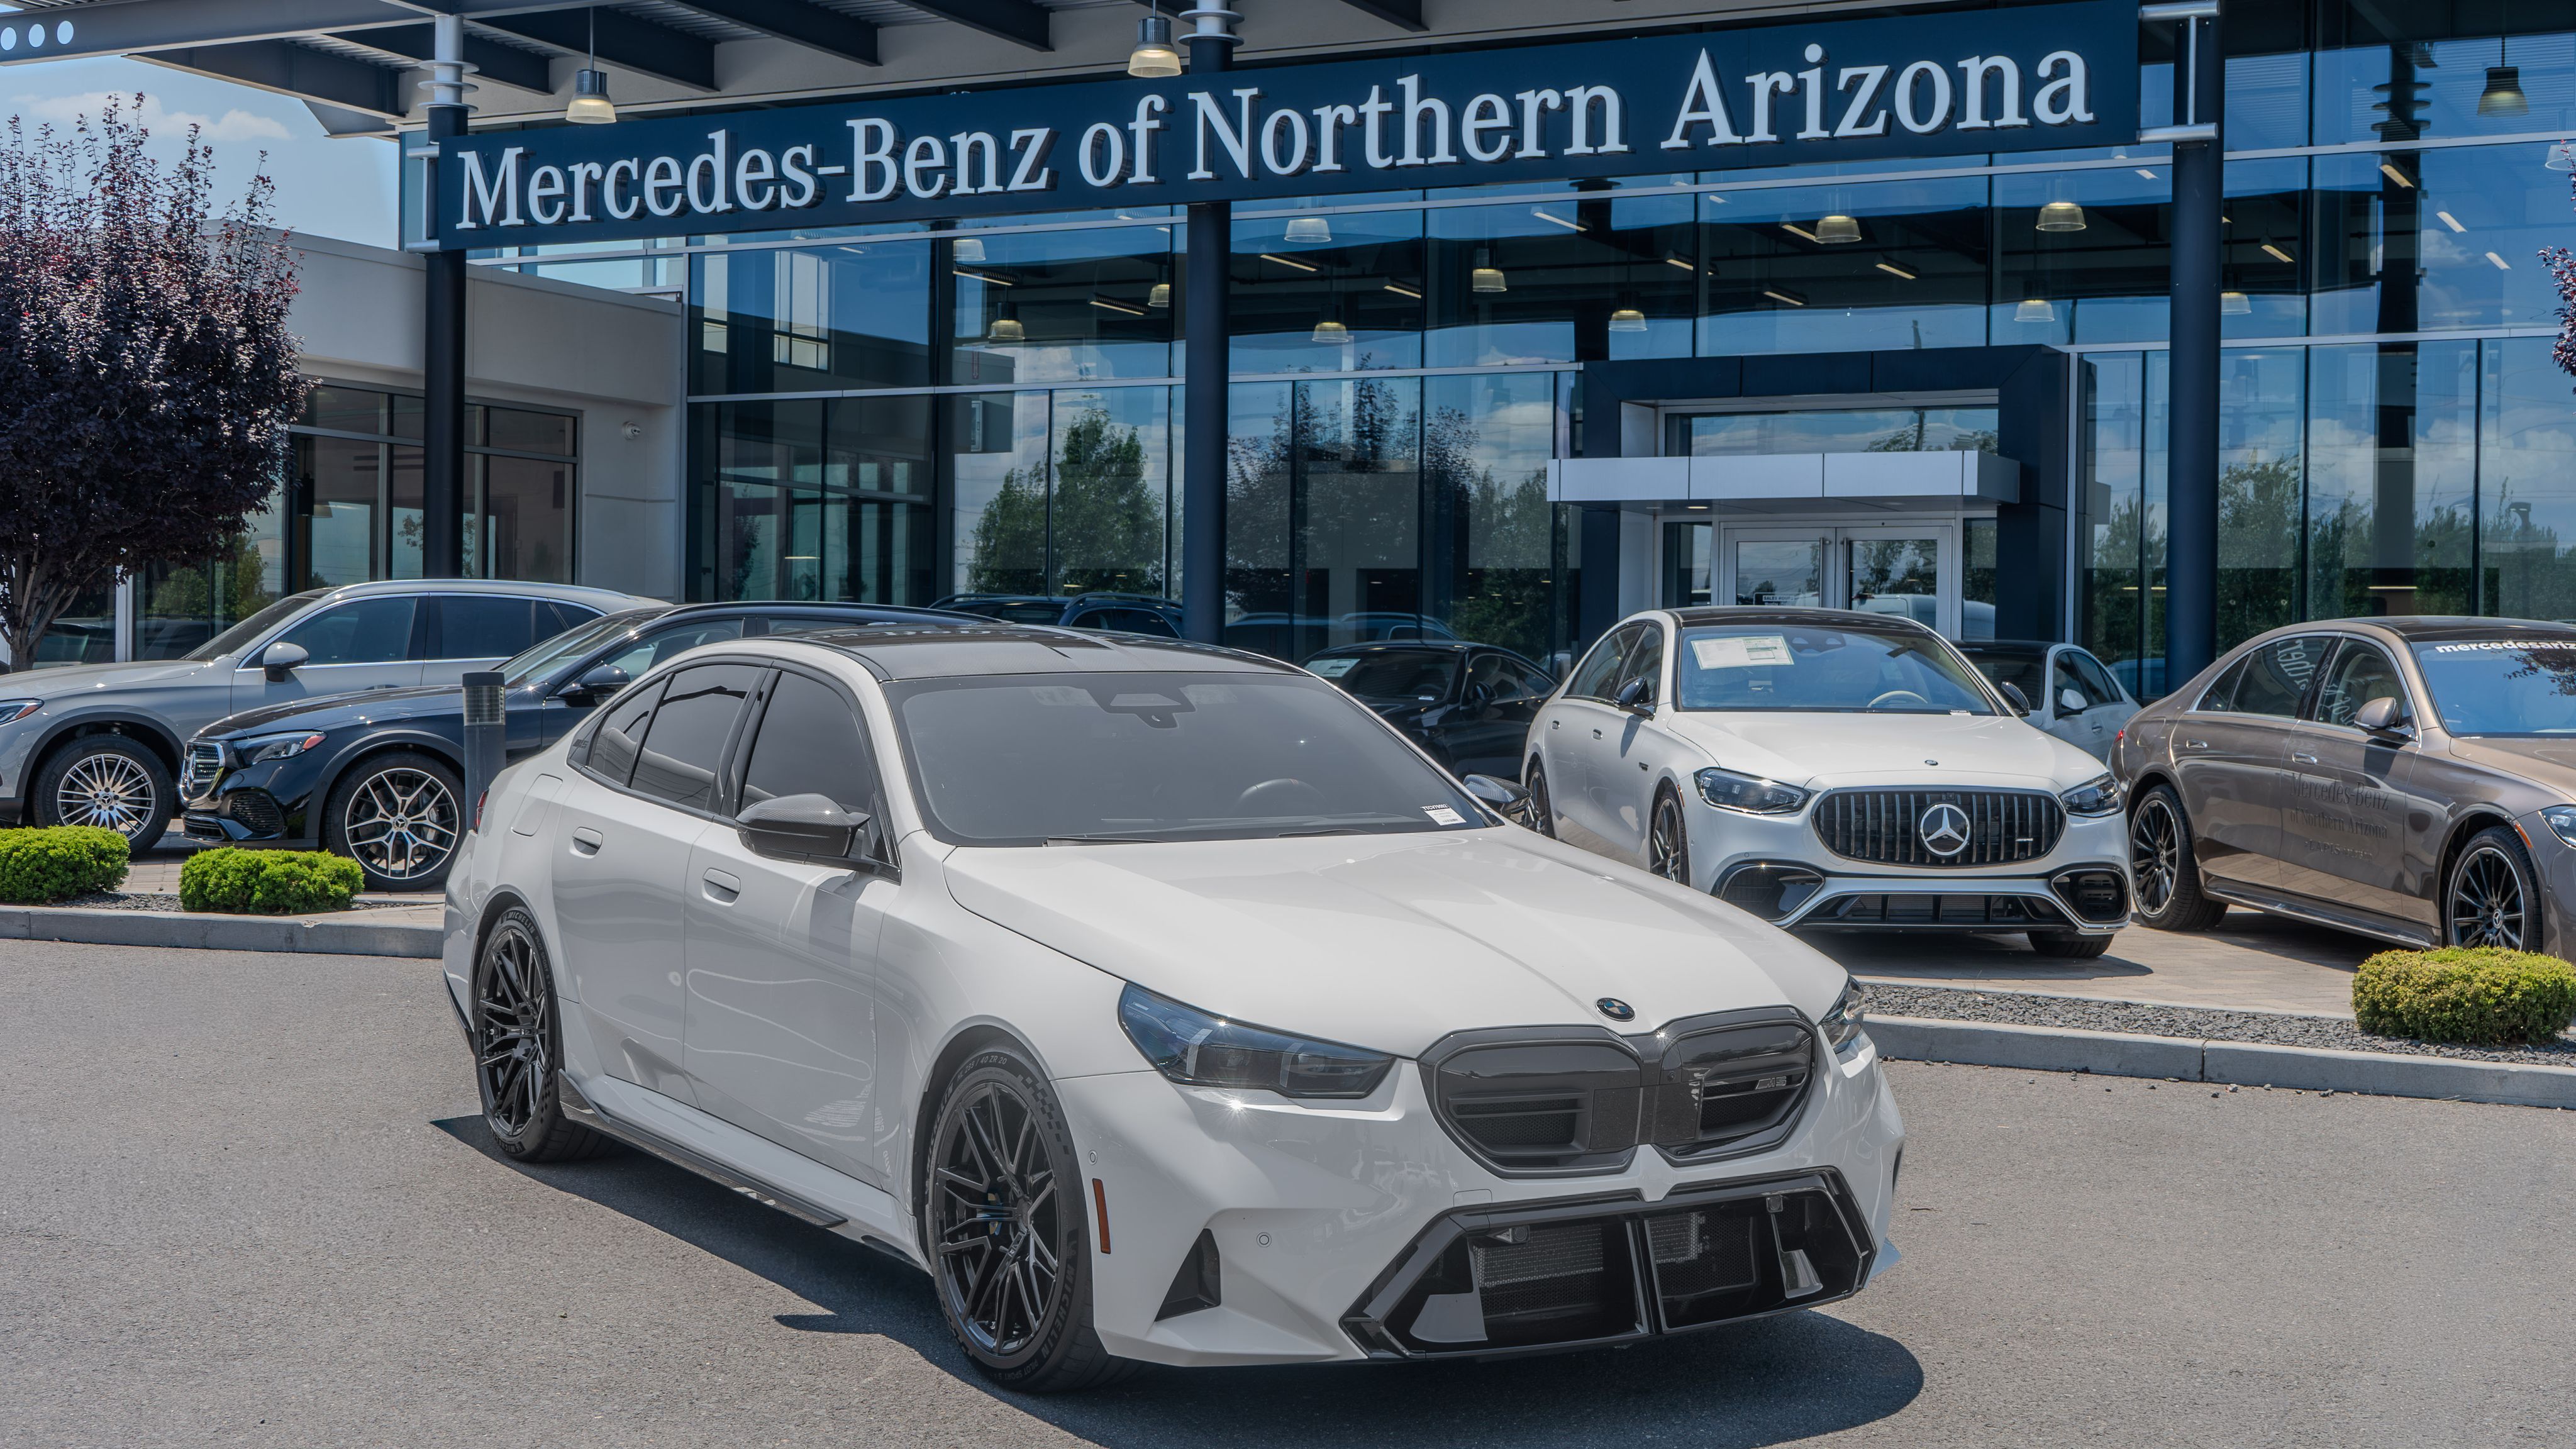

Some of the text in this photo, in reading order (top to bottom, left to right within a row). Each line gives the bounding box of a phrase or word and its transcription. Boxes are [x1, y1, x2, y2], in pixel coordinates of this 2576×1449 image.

[457, 44, 2094, 228] Mercedes-Benz of Northern Arizona
[2290, 773, 2389, 811] Mercedes-Benz
[2301, 808, 2345, 832] Northern
[2348, 817, 2388, 839] Arizona
[508, 911, 536, 934] MICHELIN
[998, 1057, 1008, 1065] 20
[1041, 1263, 1075, 1358] MICHELIN
